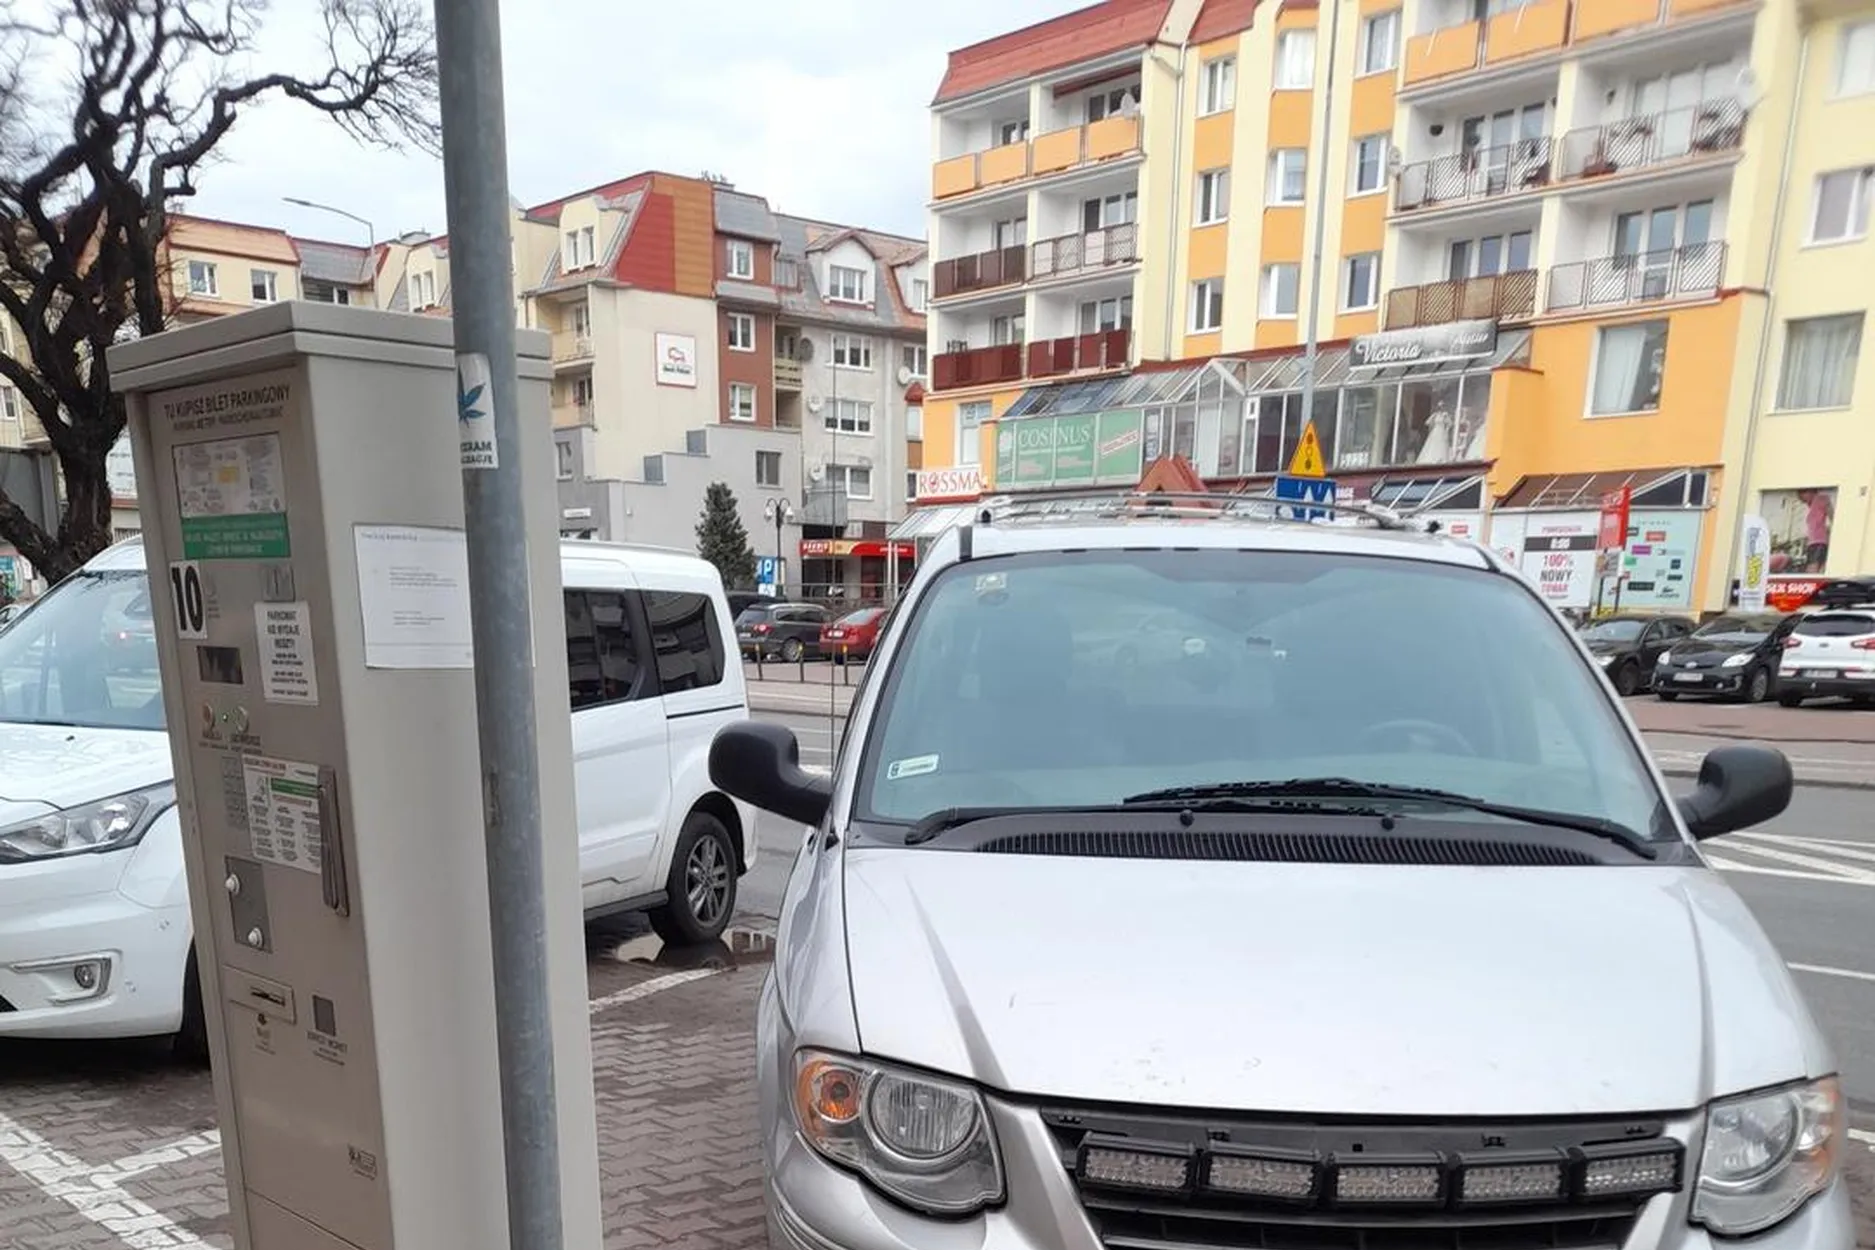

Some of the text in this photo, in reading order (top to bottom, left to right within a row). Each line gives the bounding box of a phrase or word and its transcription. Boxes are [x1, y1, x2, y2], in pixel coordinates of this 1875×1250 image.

[1356, 341, 1423, 363] Victoria
[1544, 553, 1574, 567] 100%
[1540, 569, 1573, 582] NOWY
[1787, 583, 1818, 596] SHOP
[171, 565, 204, 632] 10
